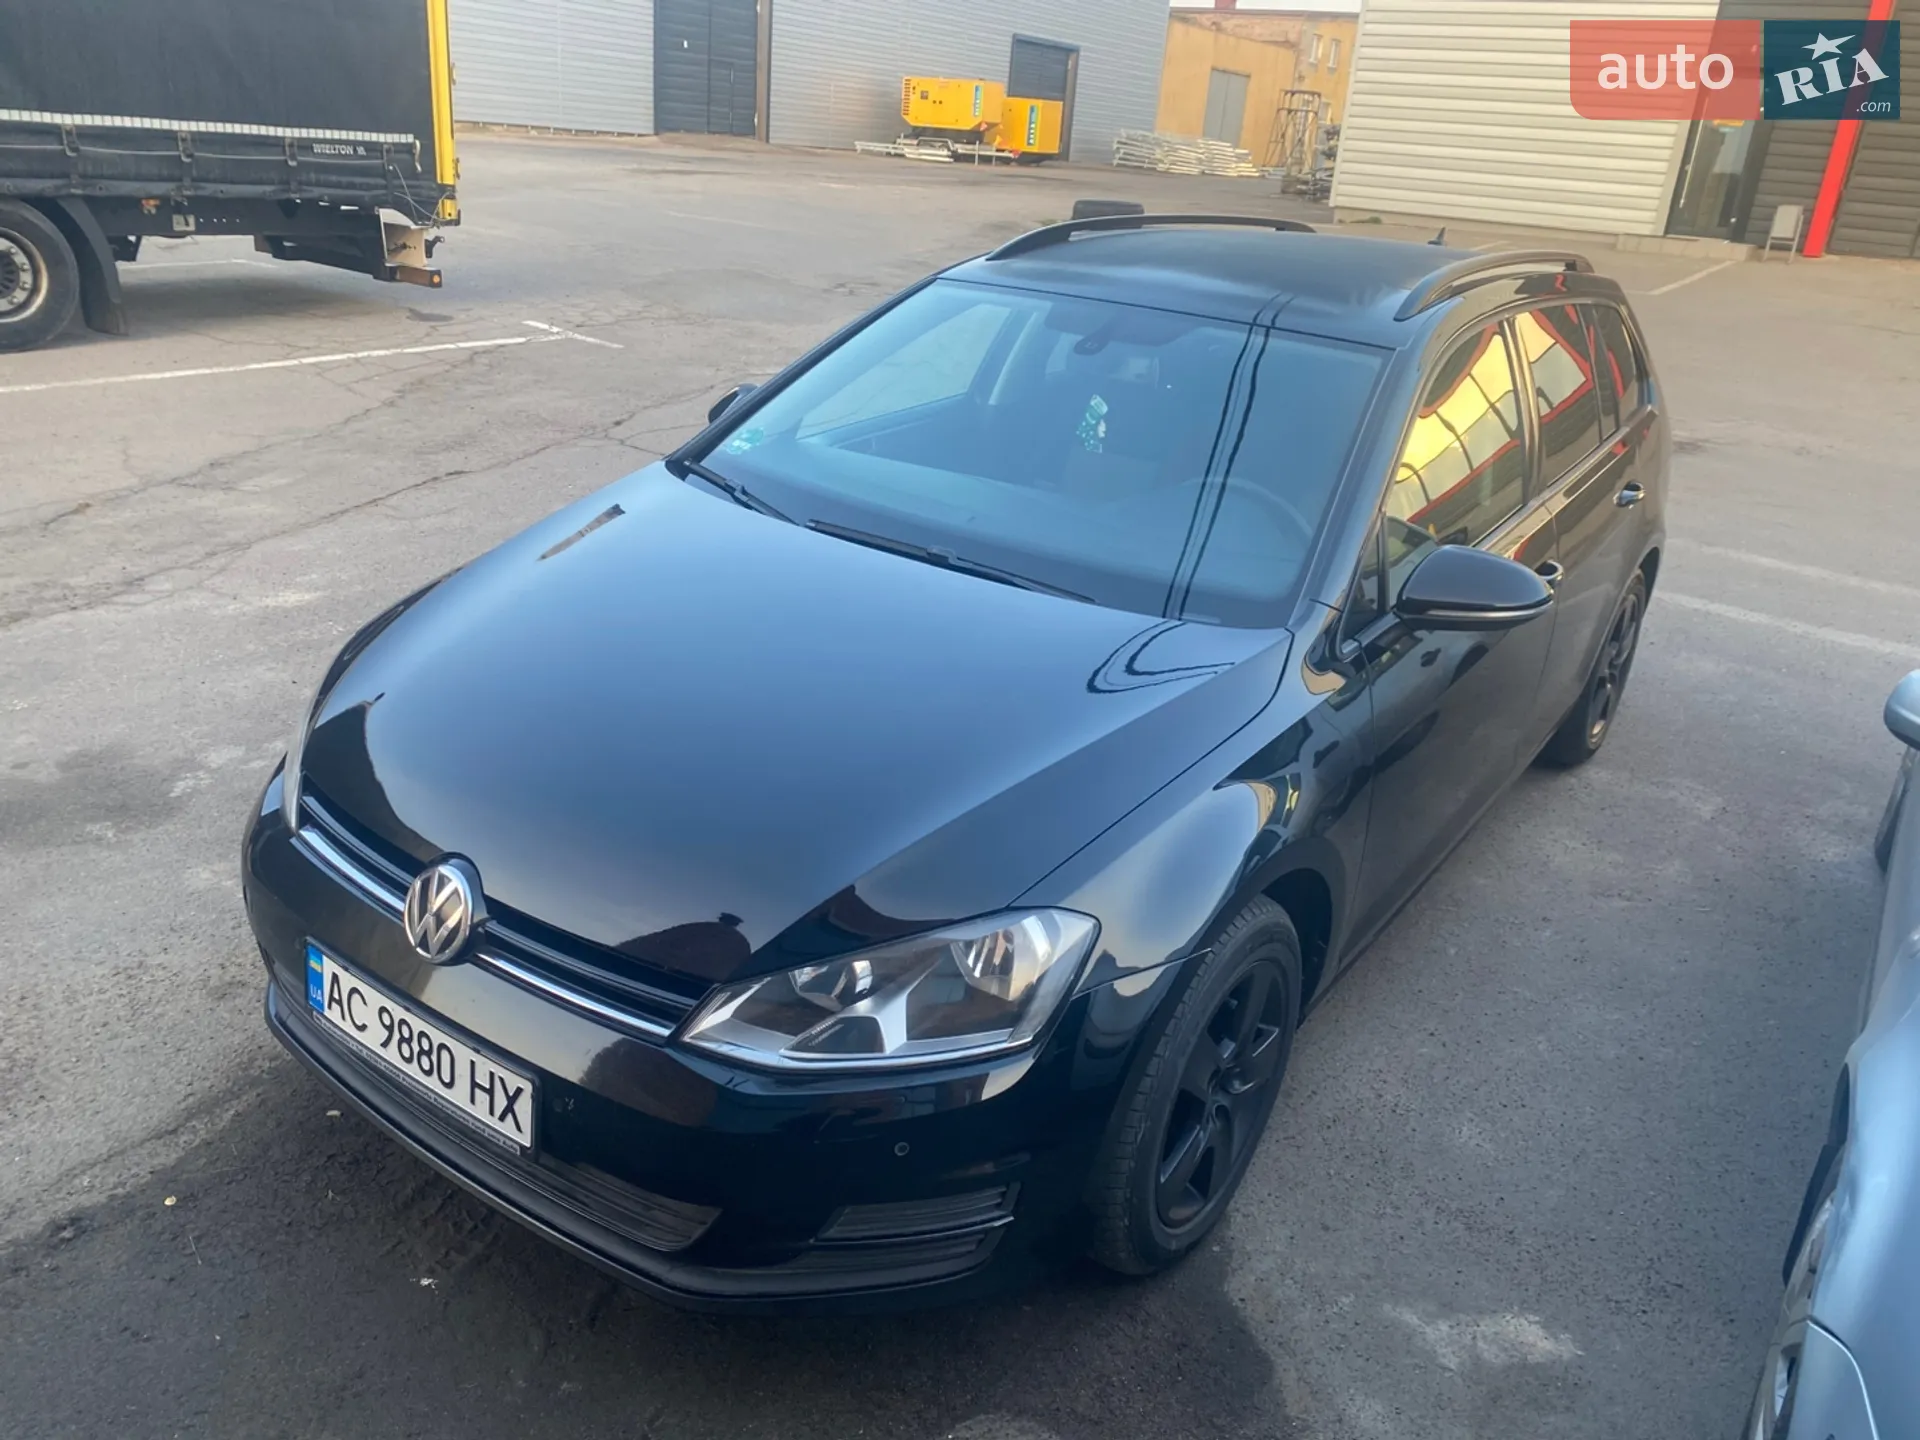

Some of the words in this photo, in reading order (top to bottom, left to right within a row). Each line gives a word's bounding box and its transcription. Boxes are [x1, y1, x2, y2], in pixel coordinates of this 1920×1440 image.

[312, 143, 354, 155] WIELTON
[310, 984, 323, 1003] UA
[327, 971, 368, 1032] AC
[378, 1005, 455, 1089] 9880
[470, 1058, 524, 1133] HX
